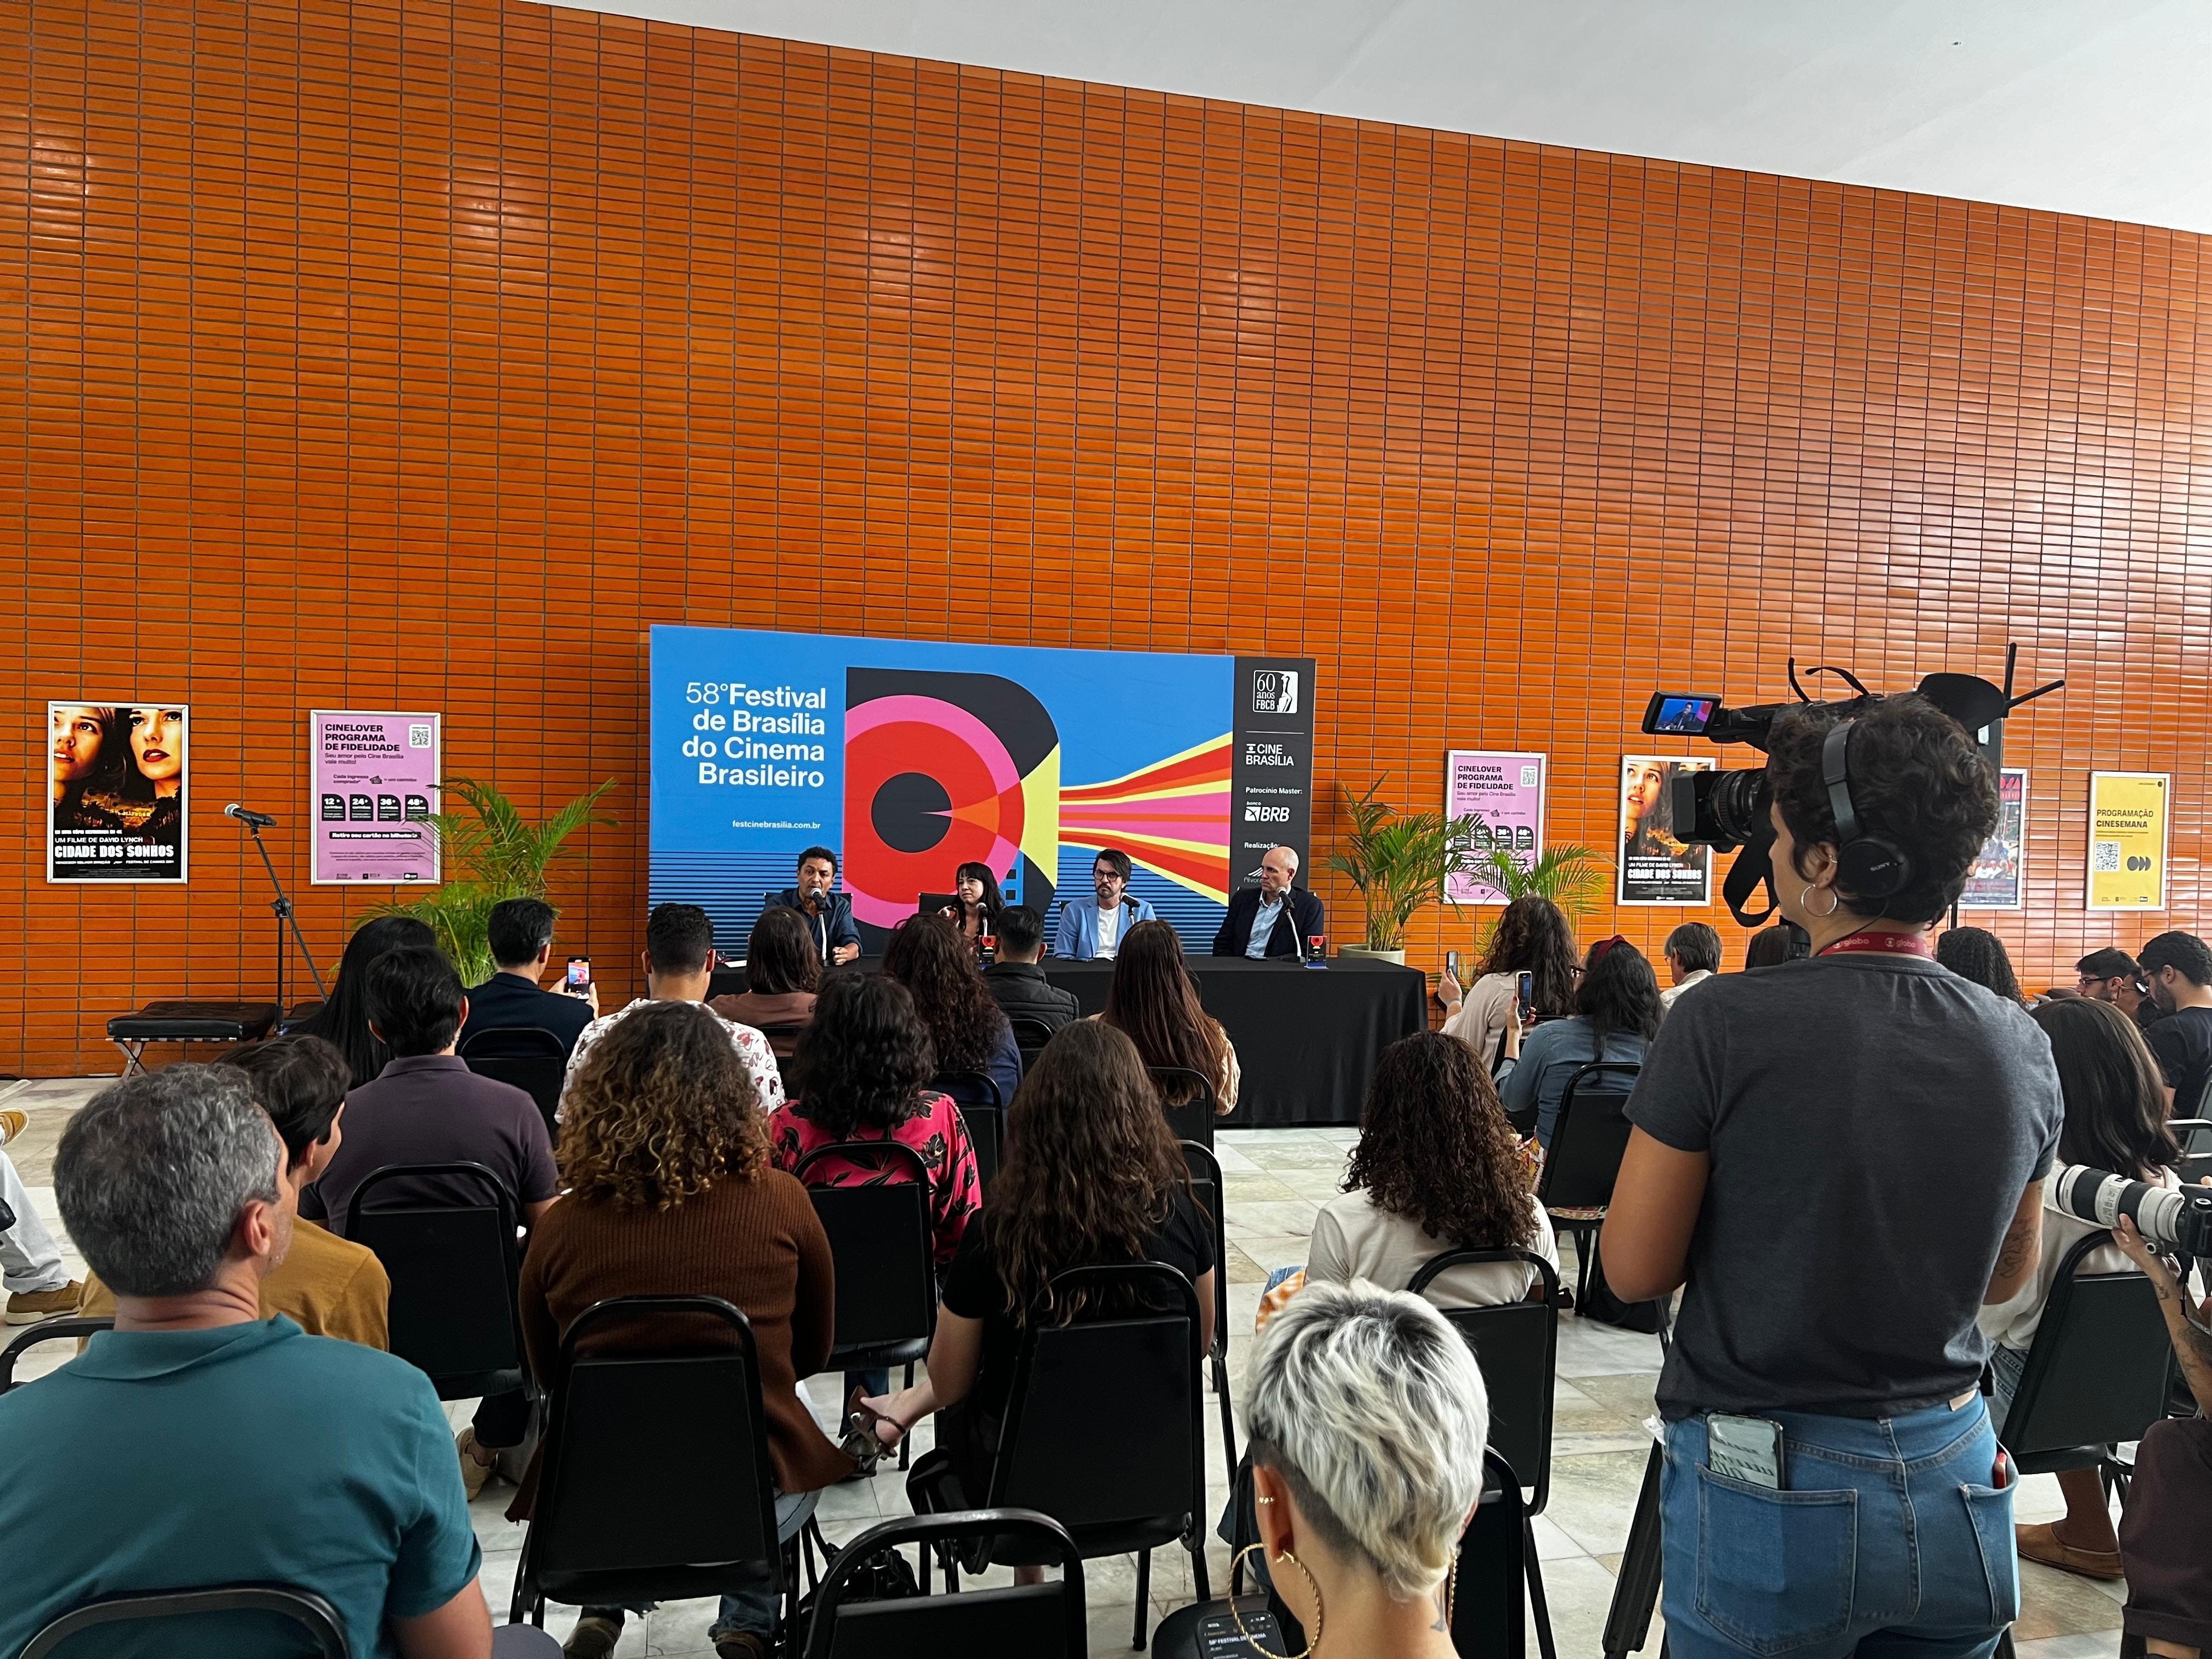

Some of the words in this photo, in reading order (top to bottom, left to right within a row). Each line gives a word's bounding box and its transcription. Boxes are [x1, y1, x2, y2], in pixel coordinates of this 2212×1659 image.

[1257, 673, 1276, 692] 60
[1256, 699, 1275, 710] FBCB
[693, 709, 726, 731] de
[733, 710, 825, 735] Brasília
[682, 735, 717, 758] do
[724, 736, 824, 761] Cinema
[1257, 743, 1283, 754] CINE
[1245, 754, 1294, 766] BRASÍLIA
[699, 762, 824, 787] Brasileiro
[1260, 806, 1290, 822] BRB
[2097, 809, 2154, 819] PROGRAMAÇÃO
[732, 820, 821, 829] festcinebrasilia.com.br
[55, 845, 96, 857] CIDADE
[99, 845, 123, 857] DOS
[127, 845, 174, 857] SONHOS
[1870, 862, 1889, 871] SONY
[1628, 868, 1654, 879] CIDADE
[1655, 869, 1671, 879] DOS
[1844, 937, 1870, 947] globo
[1896, 939, 1916, 947] globo
